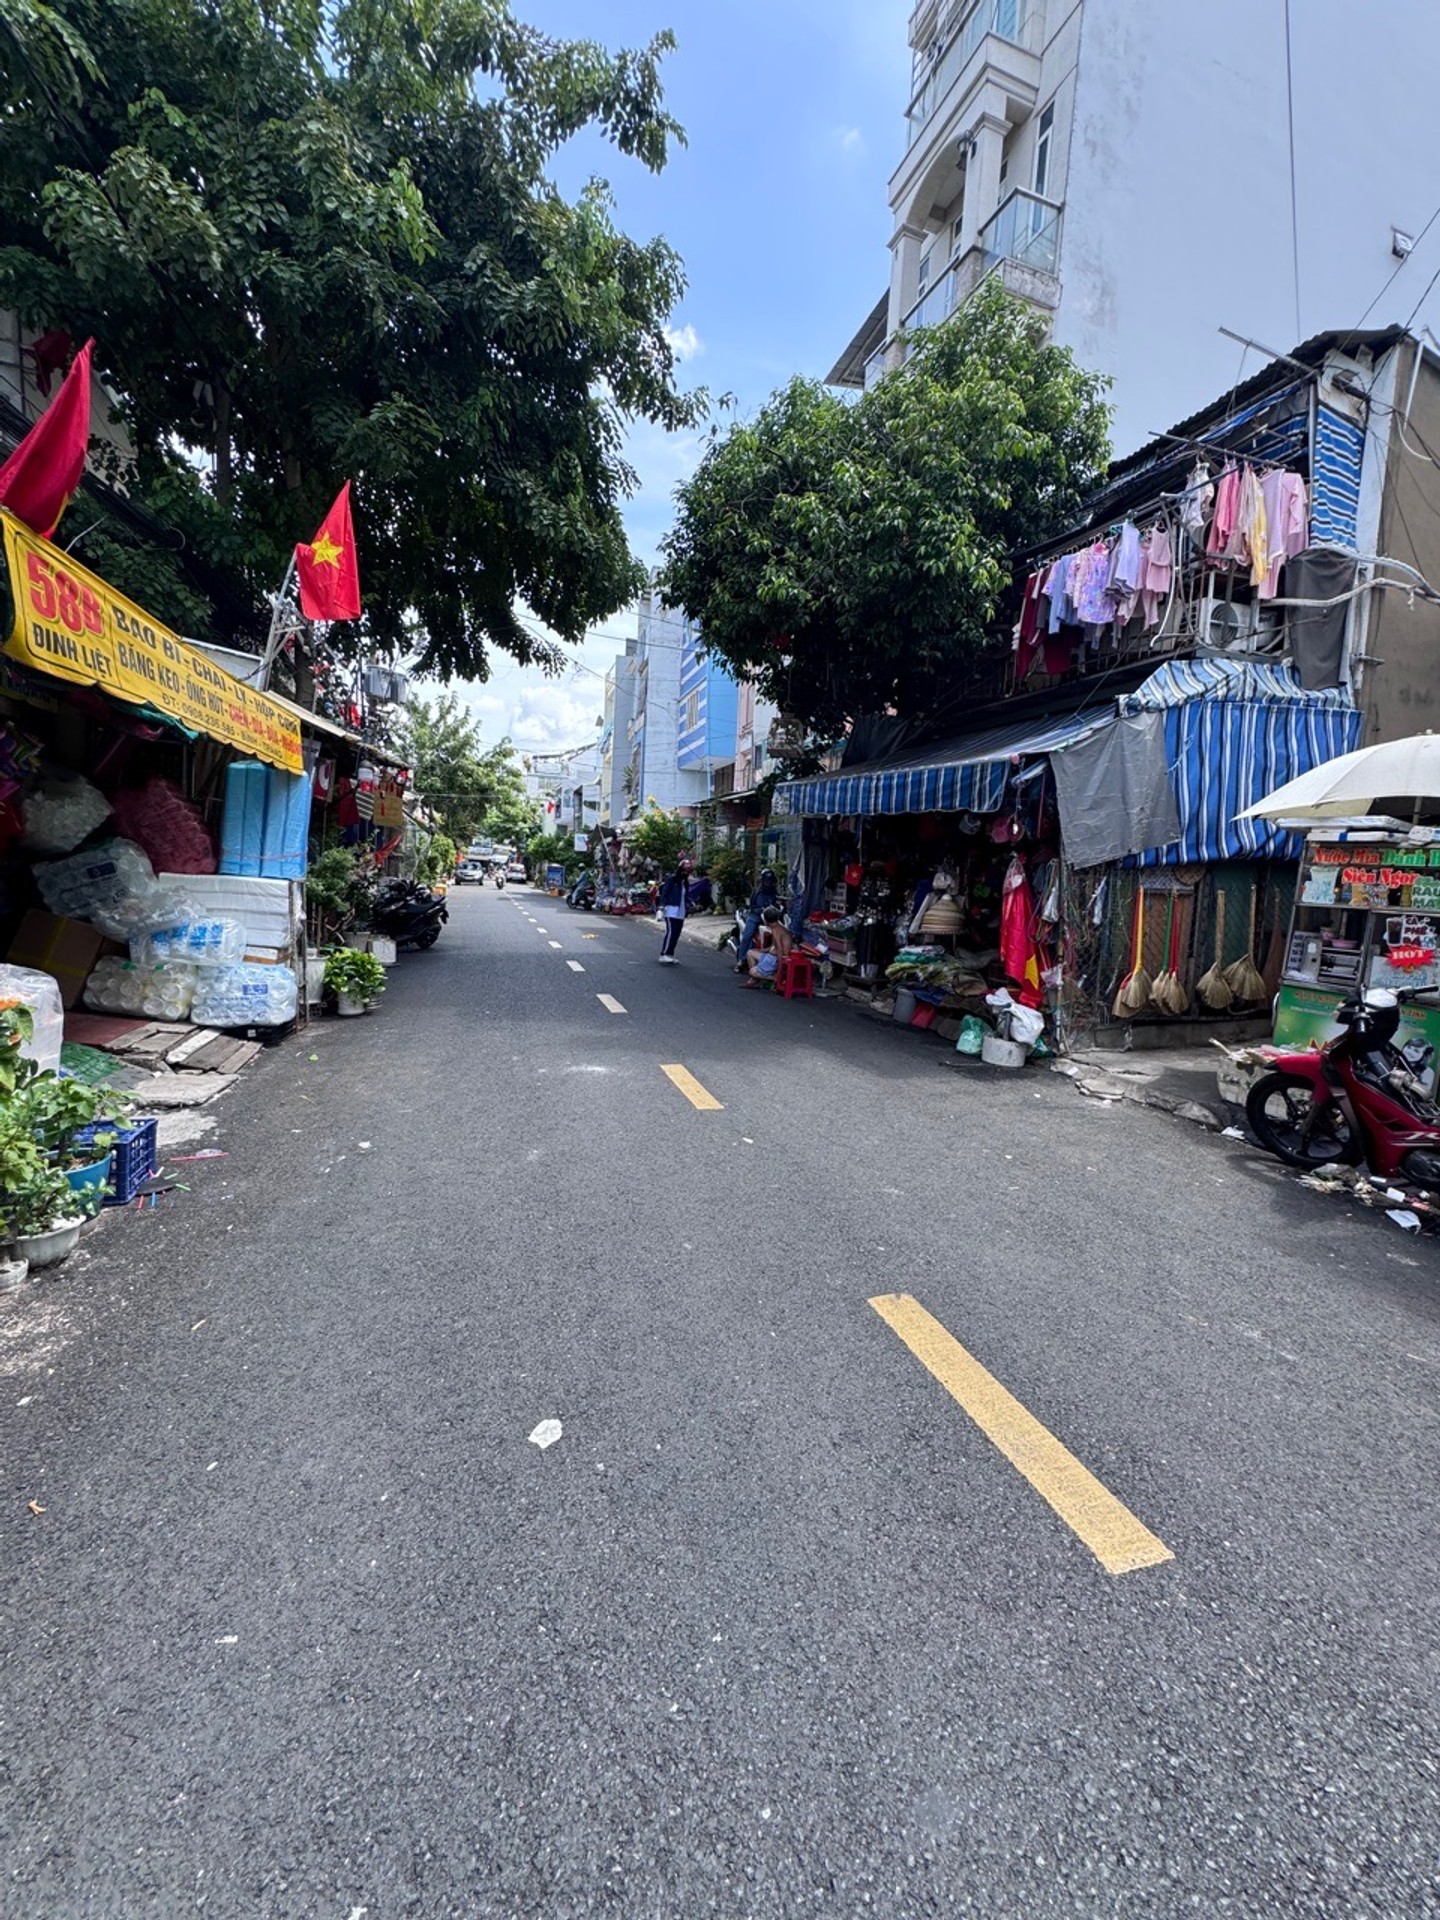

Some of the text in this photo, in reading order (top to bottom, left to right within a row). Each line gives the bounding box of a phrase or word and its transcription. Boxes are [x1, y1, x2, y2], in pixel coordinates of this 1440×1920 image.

[112, 605, 157, 650] BAO
[192, 657, 227, 693] CHAI
[233, 684, 247, 705] LY
[118, 640, 156, 682] BĂNG
[157, 663, 180, 695] KEO
[1391, 949, 1426, 960] HOT
